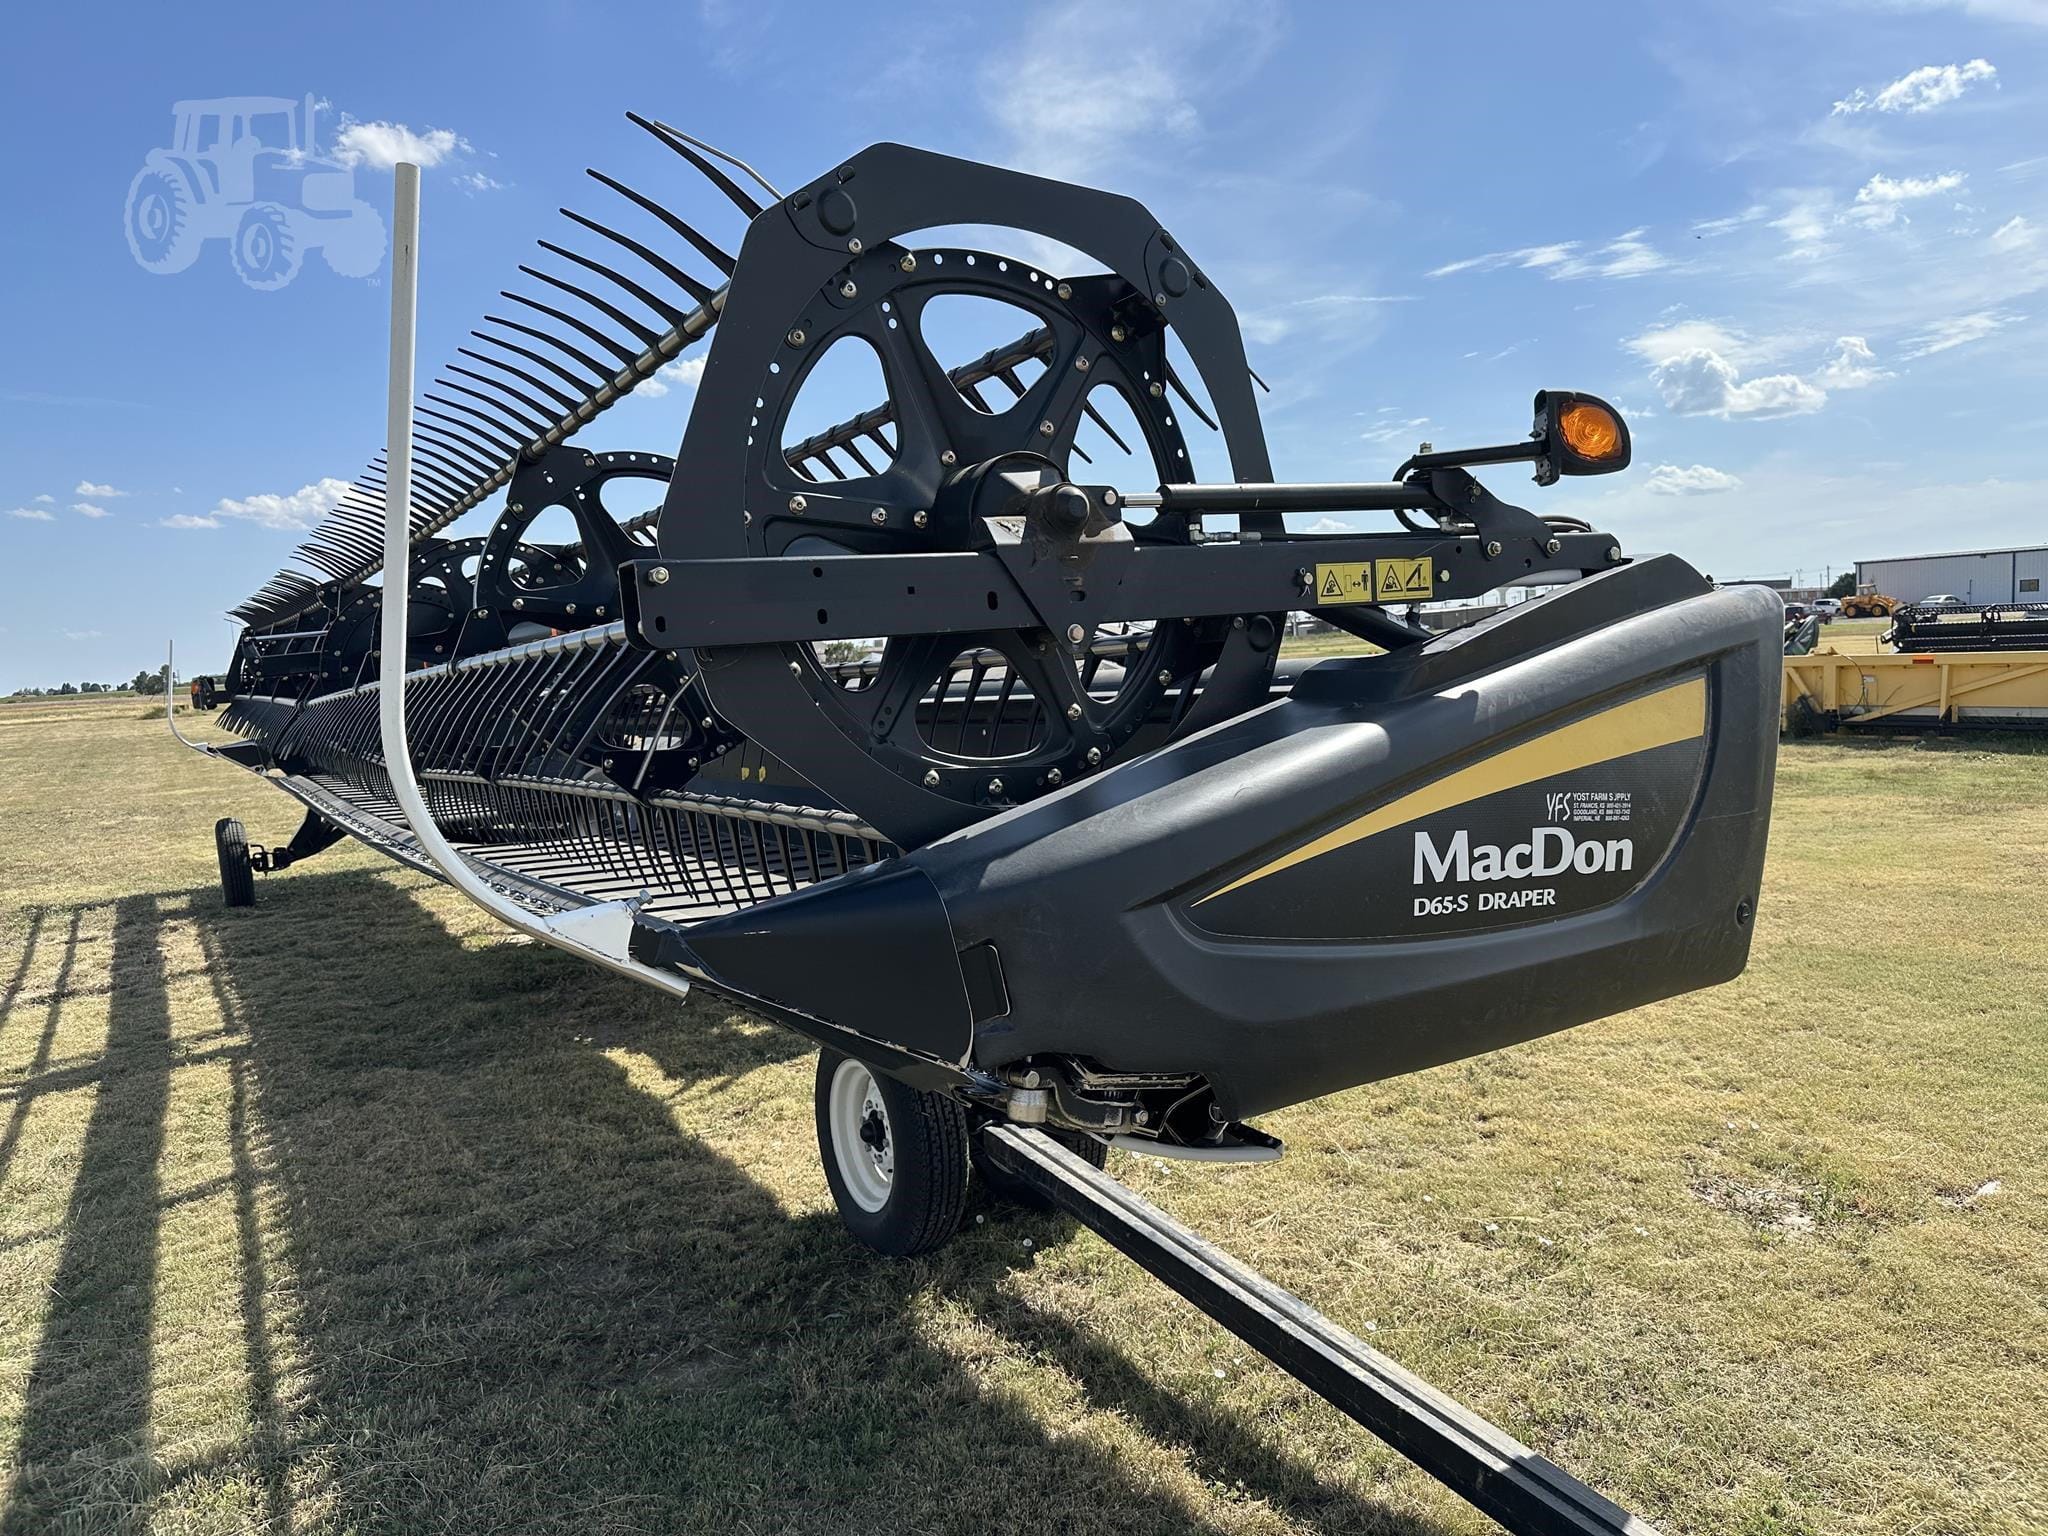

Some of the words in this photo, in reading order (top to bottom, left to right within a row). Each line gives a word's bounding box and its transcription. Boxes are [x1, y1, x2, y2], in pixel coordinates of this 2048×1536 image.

[1546, 792, 1571, 822] YFS
[1572, 792, 1589, 801] YOST
[1590, 792, 1608, 801] FARM
[1413, 826, 1634, 885] MacDon
[1413, 894, 1469, 917] D65-S
[1478, 888, 1556, 911] DRAPER
